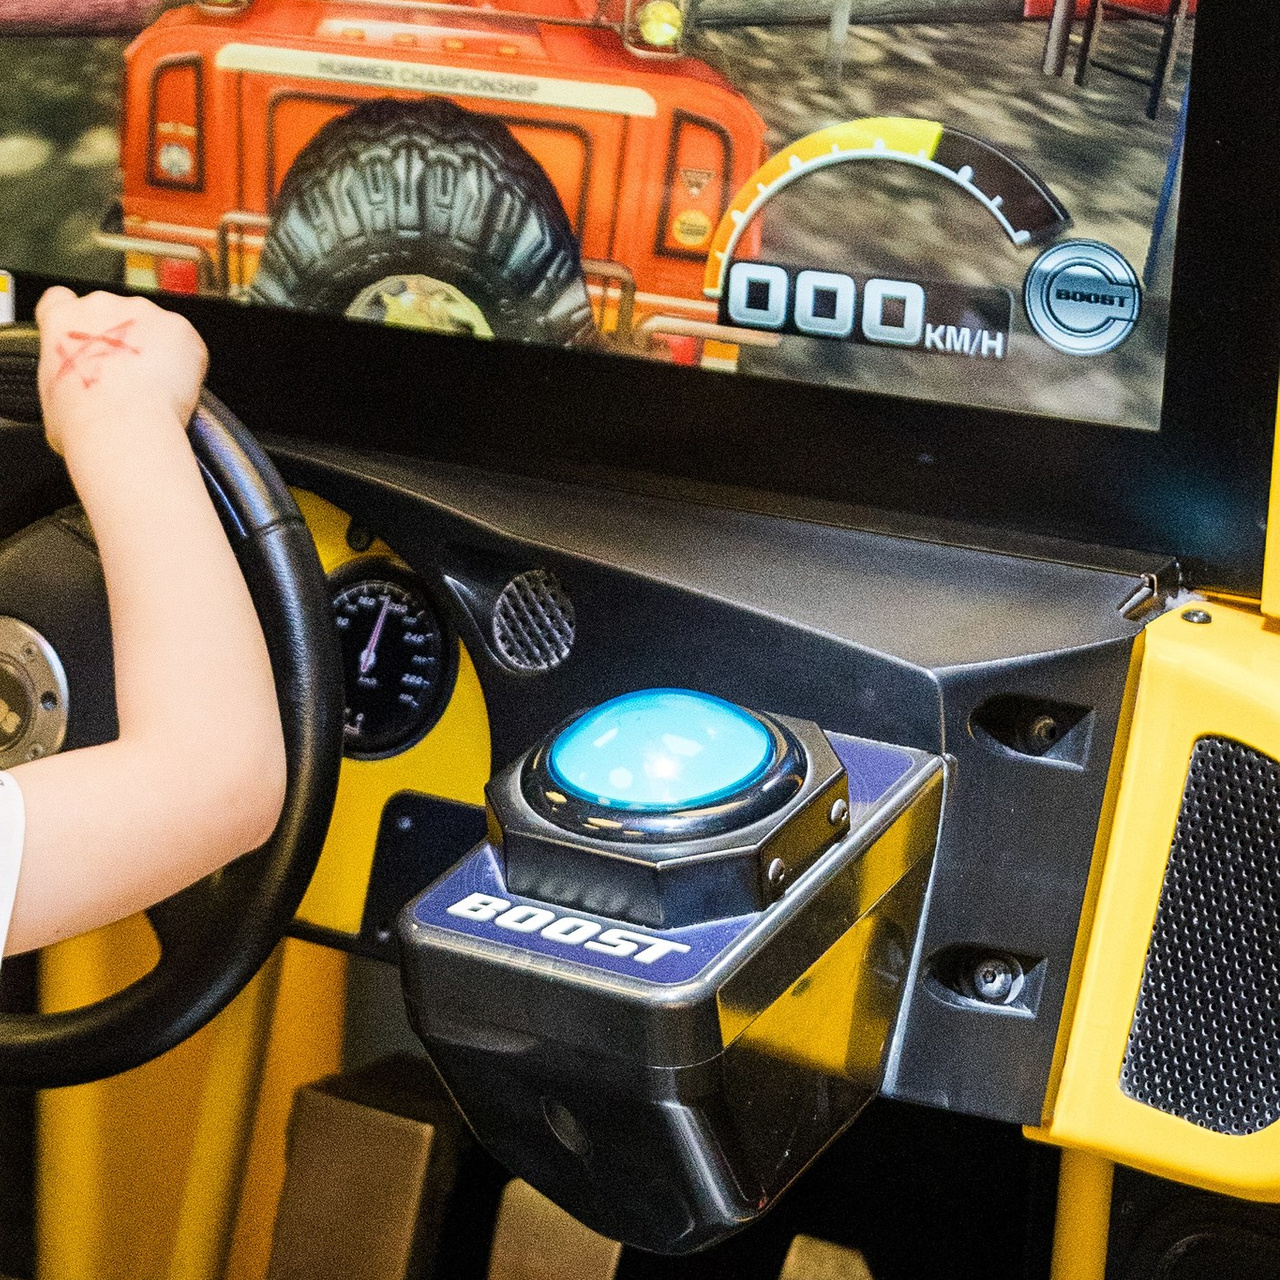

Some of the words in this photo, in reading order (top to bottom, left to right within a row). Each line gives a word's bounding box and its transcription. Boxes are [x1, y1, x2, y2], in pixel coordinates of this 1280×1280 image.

[318, 61, 395, 82] HUMMER
[400, 66, 538, 96] CHAMPIONSHIP
[728, 262, 925, 346] 000
[925, 323, 1005, 360] KM/H
[1056, 287, 1130, 309] BOOST
[446, 892, 691, 965] BOOST
